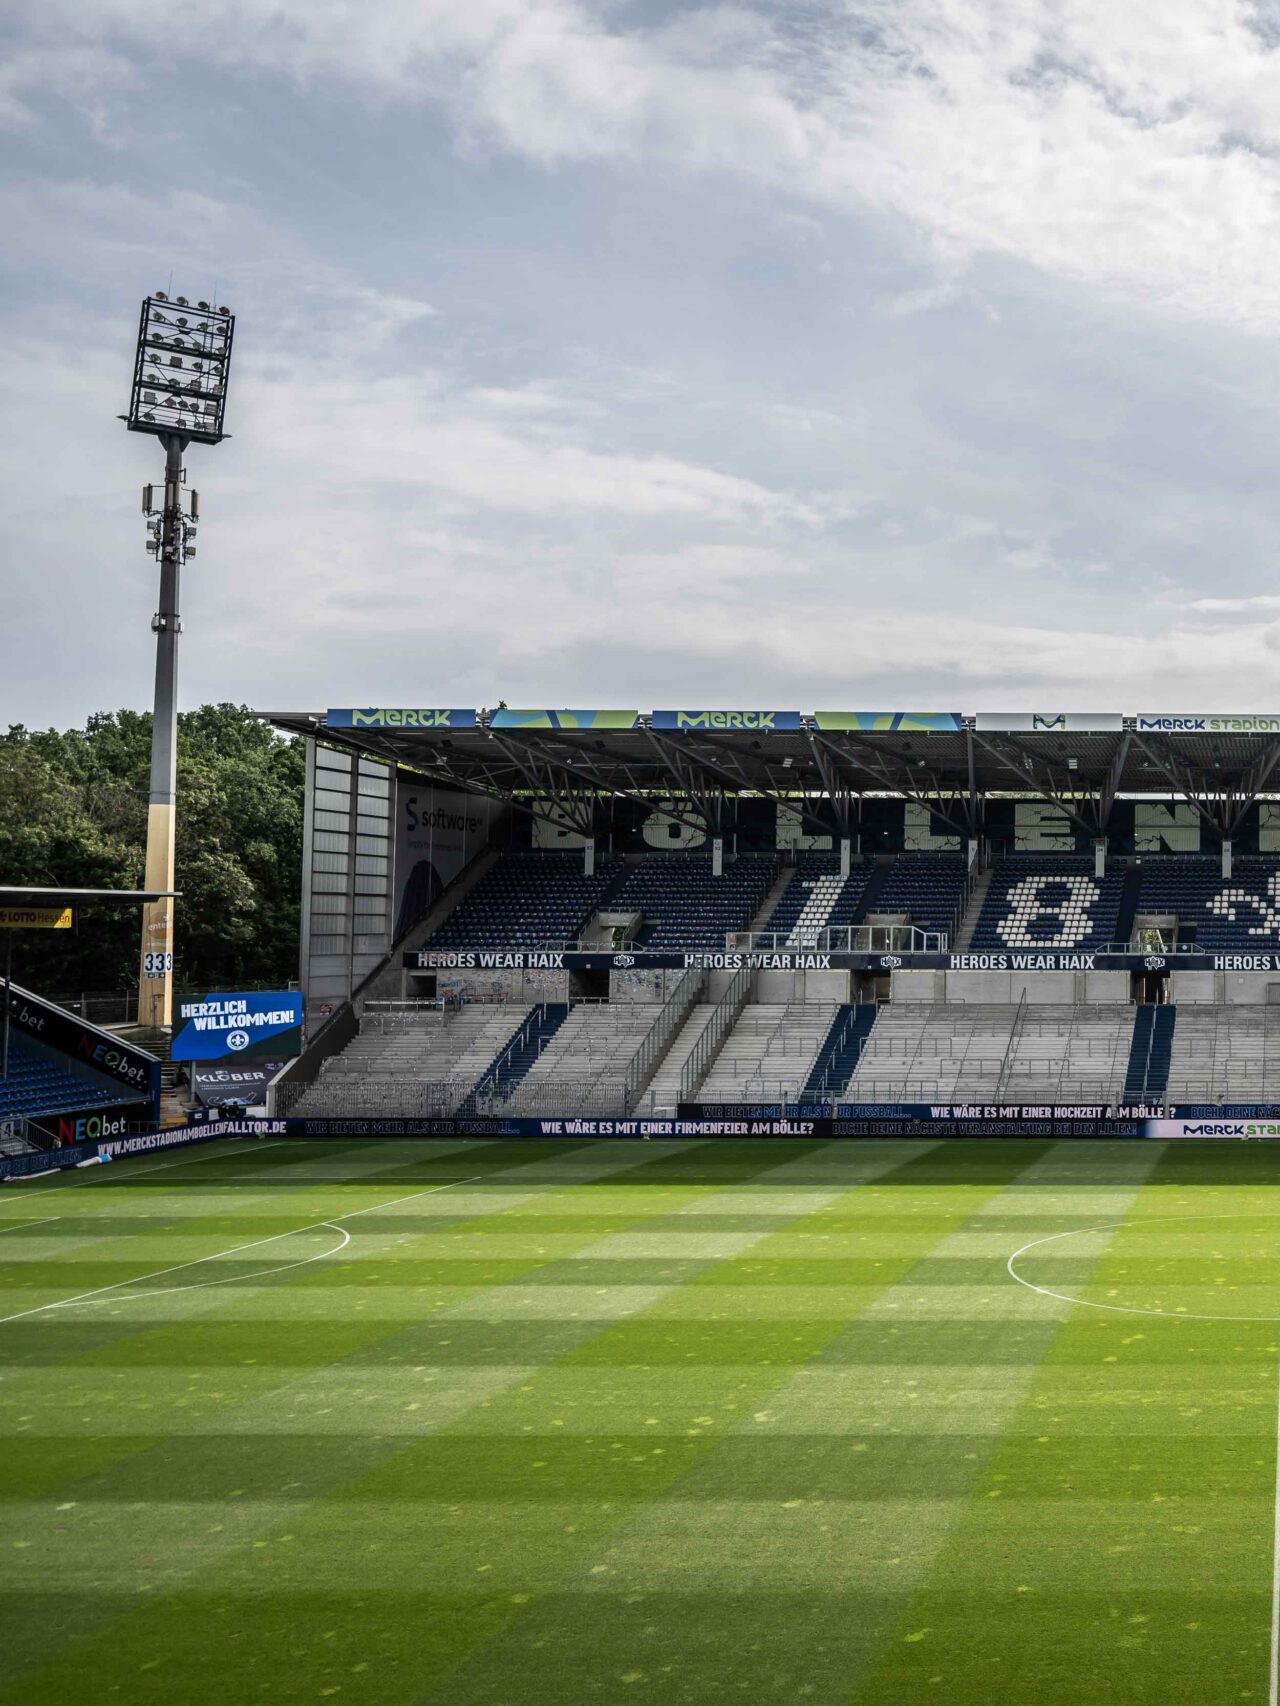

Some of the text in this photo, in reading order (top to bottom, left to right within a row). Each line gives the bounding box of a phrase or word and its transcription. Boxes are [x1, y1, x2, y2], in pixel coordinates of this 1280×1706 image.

[422, 808, 477, 833] software
[8, 912, 70, 923] LOTTO Hessen
[418, 954, 563, 967] HEROES WEAR HAIX
[684, 955, 830, 968] HEROES WEAR HAIX
[951, 955, 1095, 969] HEROES WEAR HAIX
[1214, 956, 1271, 970] HEROES
[181, 1000, 247, 1018] HERZLICH
[194, 1010, 295, 1031] WILLKOMMEN!
[931, 1106, 950, 1118] WIE
[953, 1104, 982, 1118] WÄRE
[984, 1106, 997, 1118] ES
[1000, 1106, 1020, 1118] MIT
[1023, 1106, 1052, 1118] EINER
[1055, 1106, 1103, 1118] HOCHZEIT
[541, 1119, 814, 1134] WIE WÄRE ES MIT EINER FIRMENFEIER AM BÖLLE?
[98, 1120, 287, 1156] WWW.MERCKSTADIONAMBOELLENFALLTOR.DE
